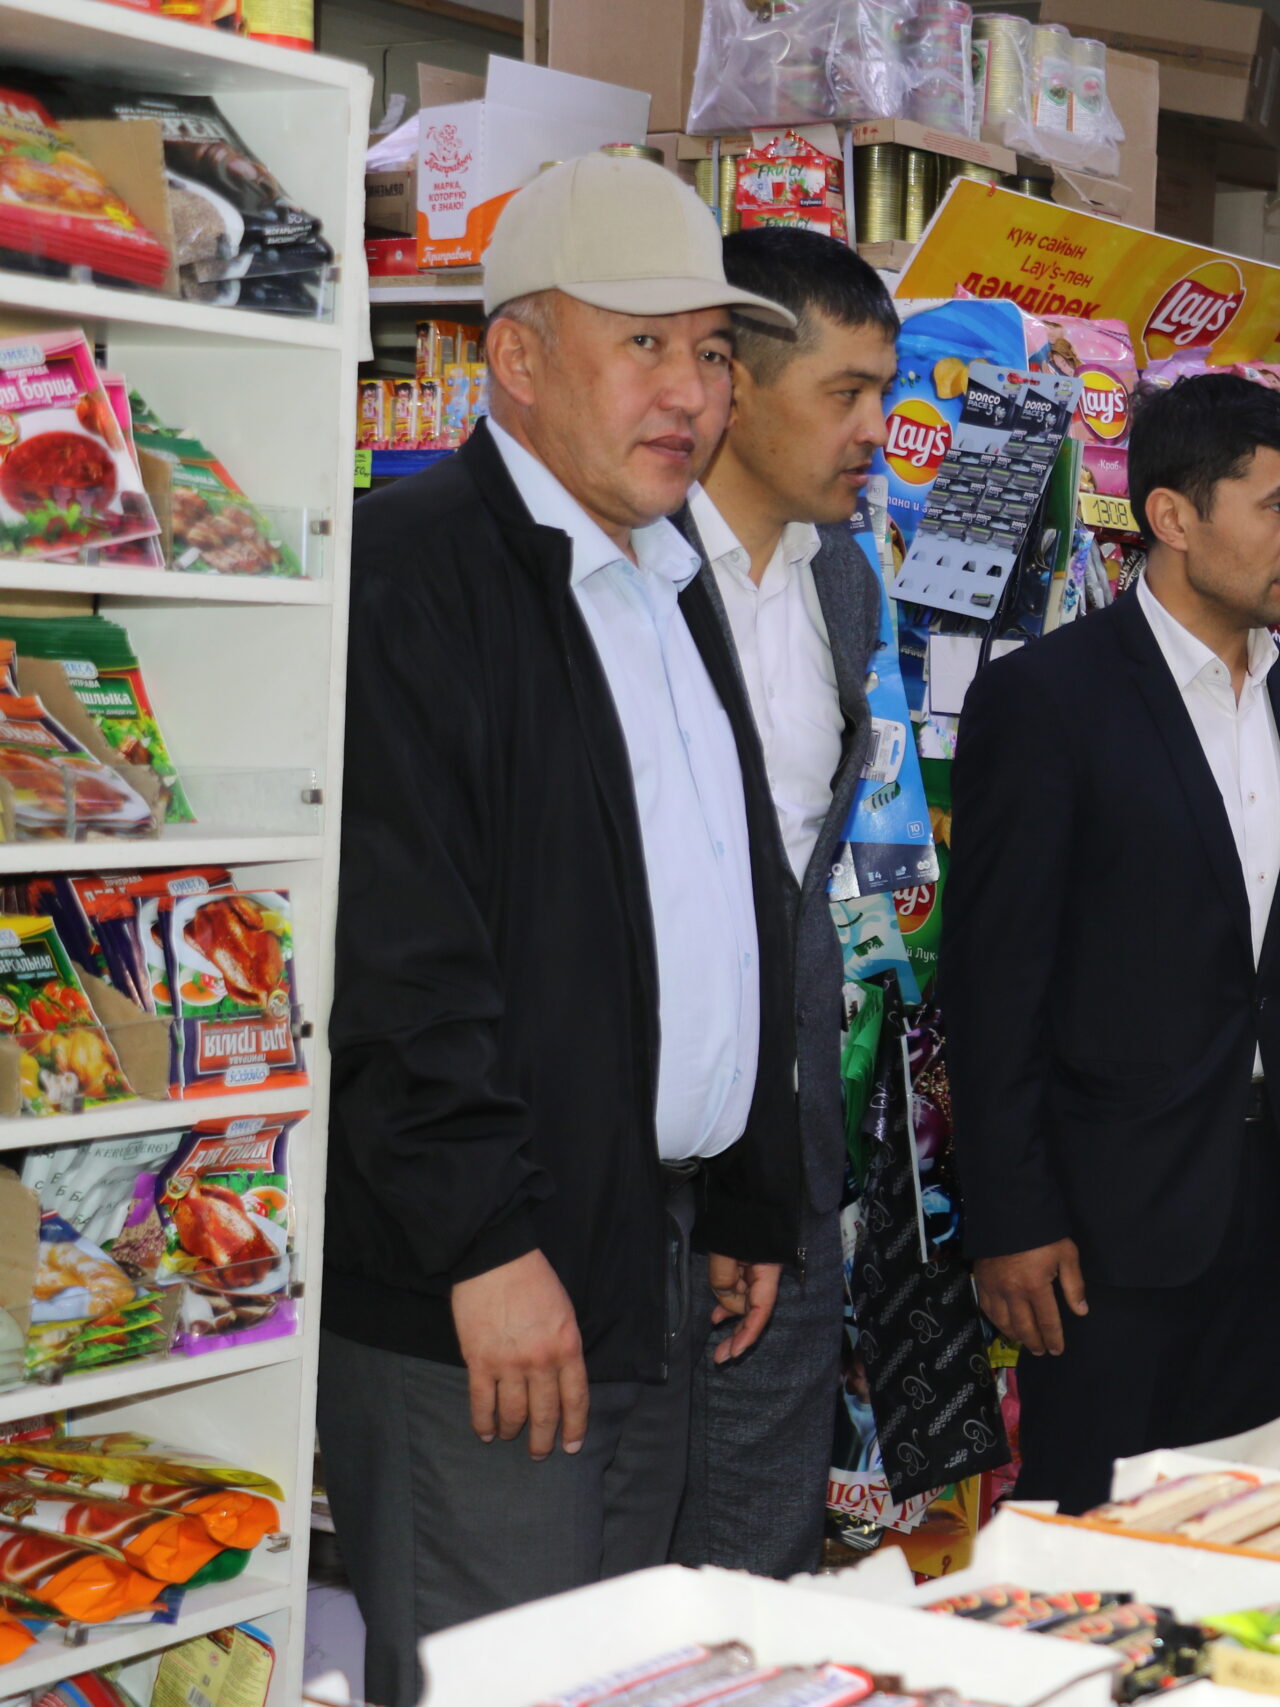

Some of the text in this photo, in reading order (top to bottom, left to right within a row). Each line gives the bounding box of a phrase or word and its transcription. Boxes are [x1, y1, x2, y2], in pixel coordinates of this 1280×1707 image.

[428, 191, 467, 202] КОТОРУЮ
[438, 202, 464, 211] ЗНАЮ!
[1007, 225, 1088, 259] күн сайын
[1020, 254, 1094, 288] Lay's-пен
[1149, 281, 1238, 347] Lay's
[20, 375, 77, 402] борща
[969, 391, 1001, 405] DORCO
[1025, 401, 1052, 412] DORCO
[886, 416, 949, 467] Lay's
